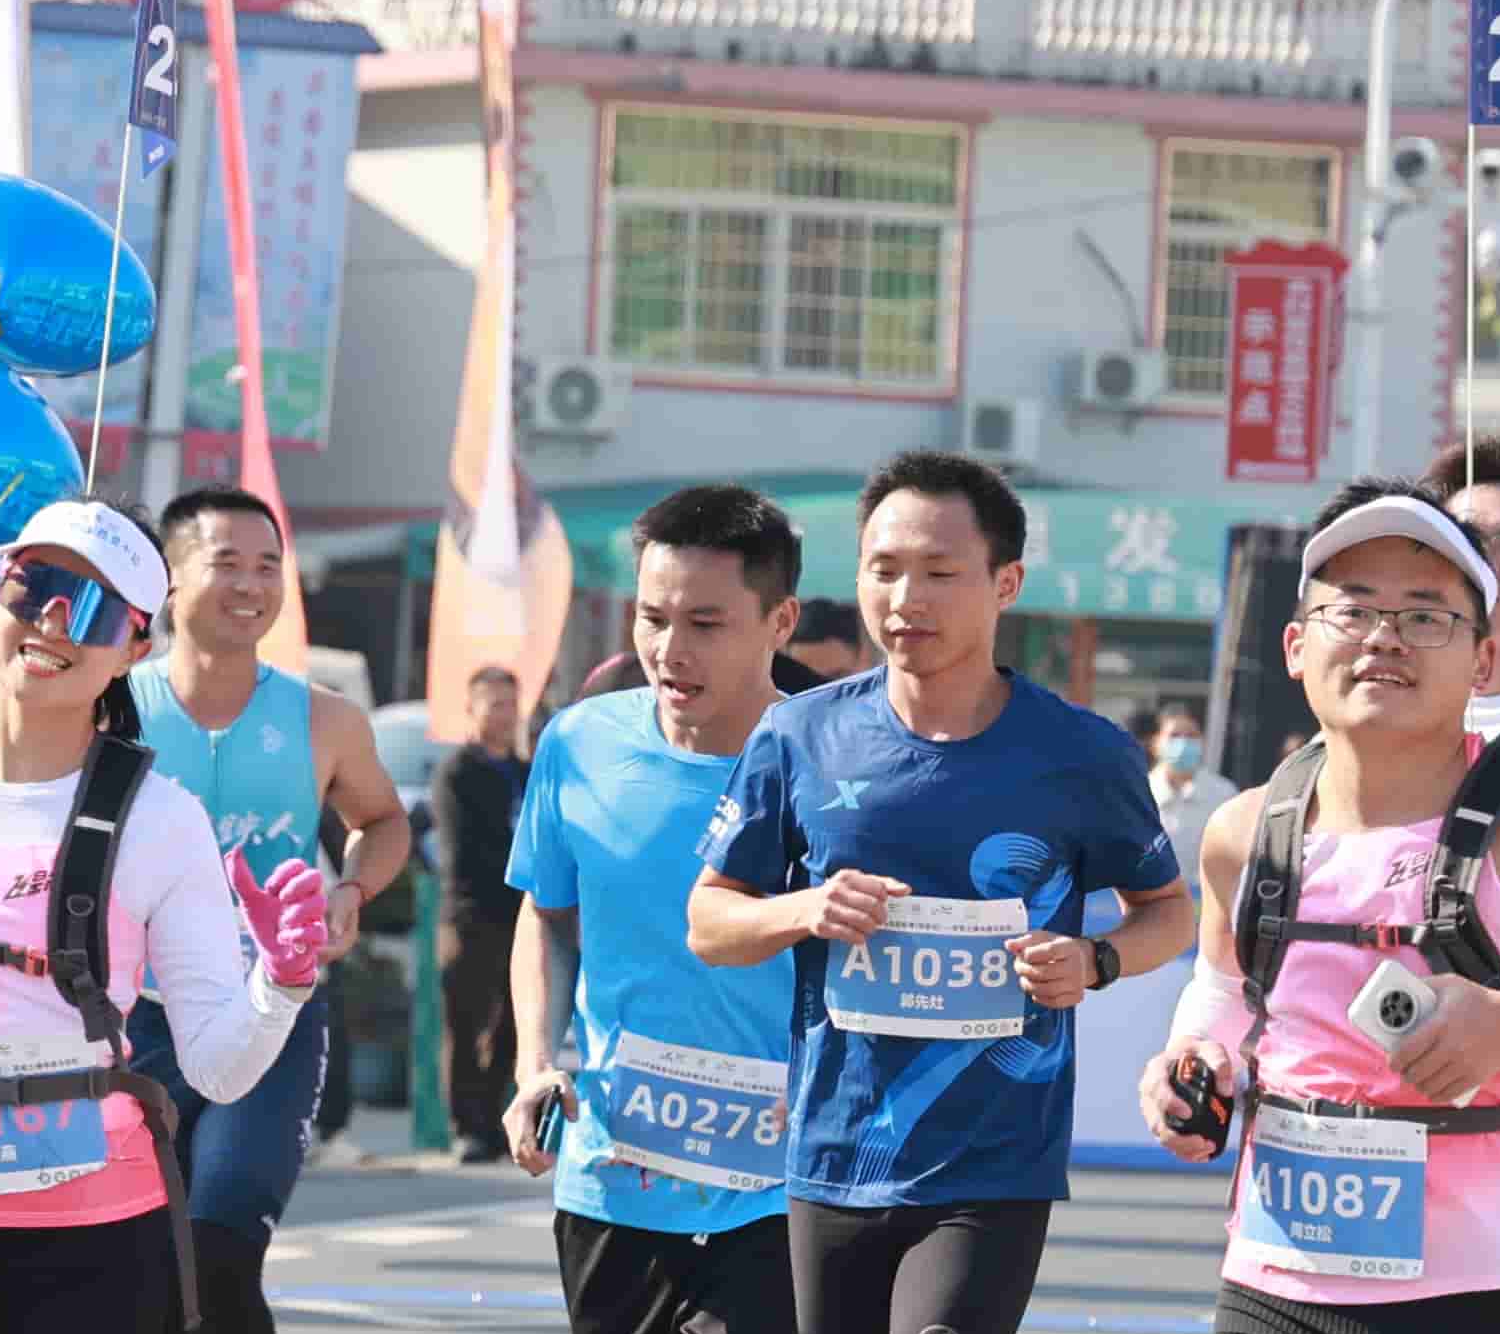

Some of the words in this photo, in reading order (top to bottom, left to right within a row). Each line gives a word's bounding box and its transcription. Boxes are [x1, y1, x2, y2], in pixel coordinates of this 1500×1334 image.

[840, 942, 1009, 988] A1038
[623, 1083, 782, 1147] A0278
[1253, 1162, 1402, 1221] A1087
